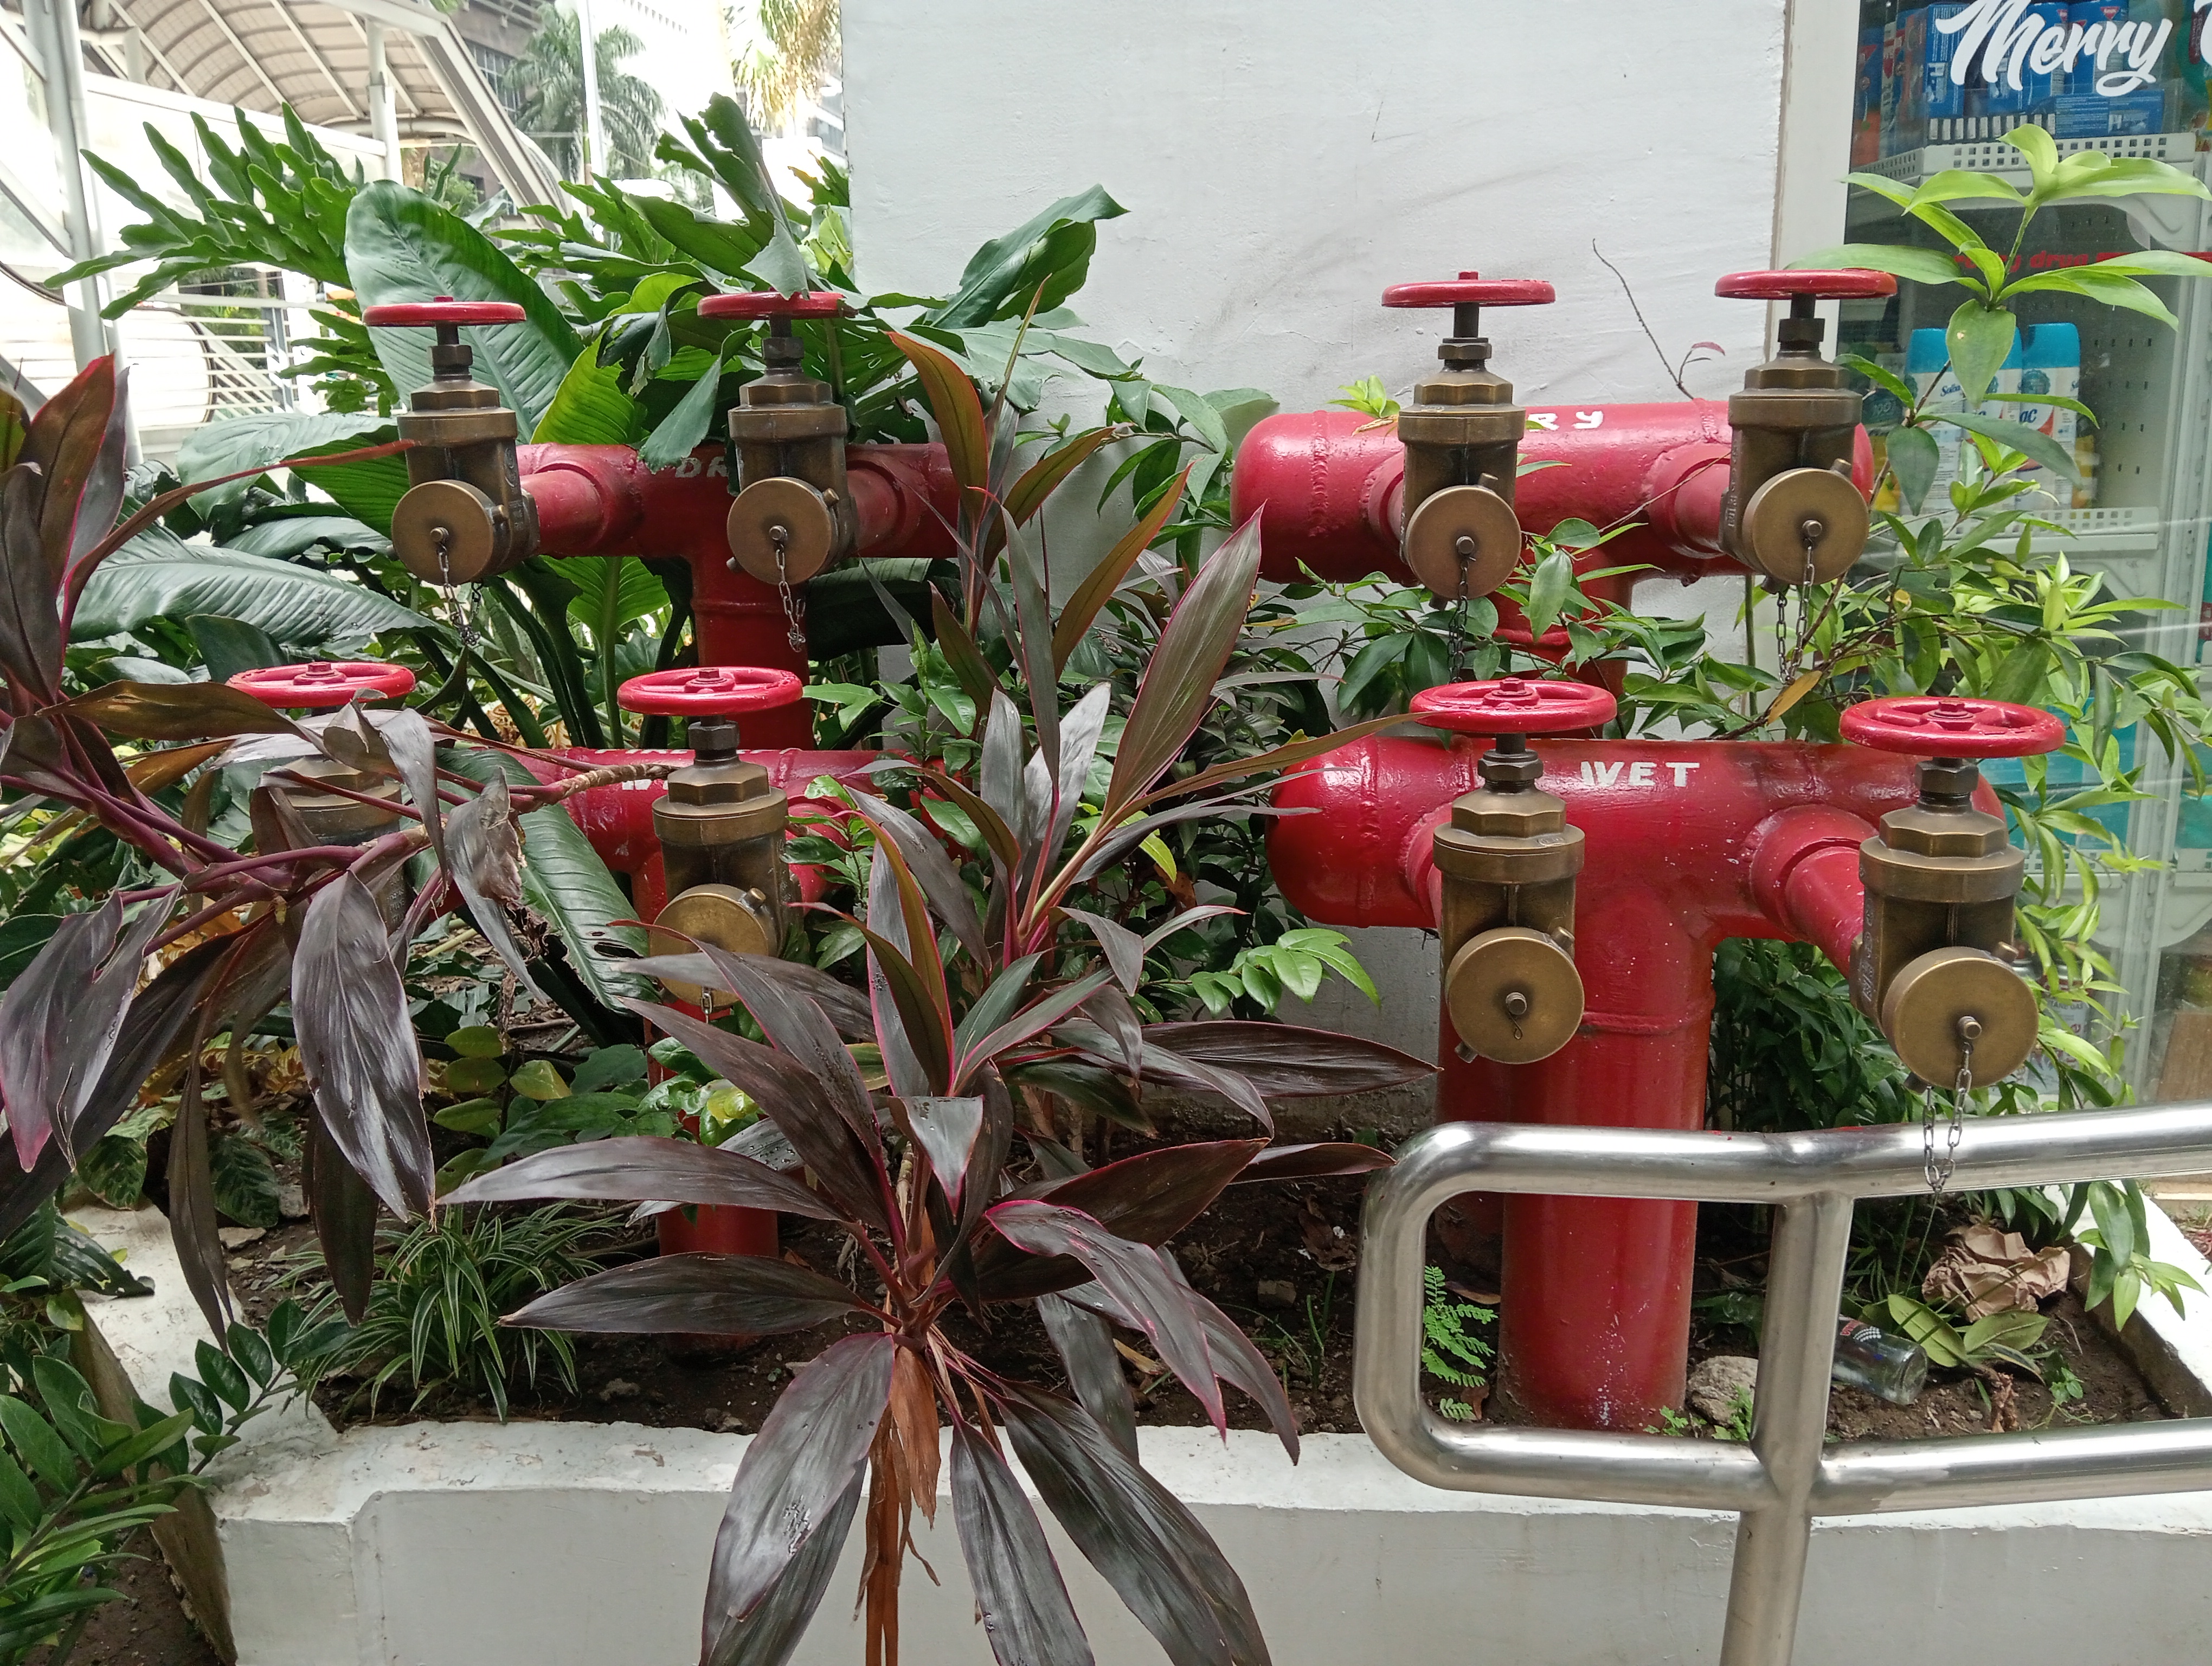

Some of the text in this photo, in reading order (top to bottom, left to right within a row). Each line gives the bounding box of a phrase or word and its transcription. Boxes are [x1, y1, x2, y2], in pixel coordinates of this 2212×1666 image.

[1935, 0, 2173, 97] Merry
[1527, 411, 1604, 432] RY
[675, 456, 728, 478] DR
[1580, 761, 1700, 787] WET
